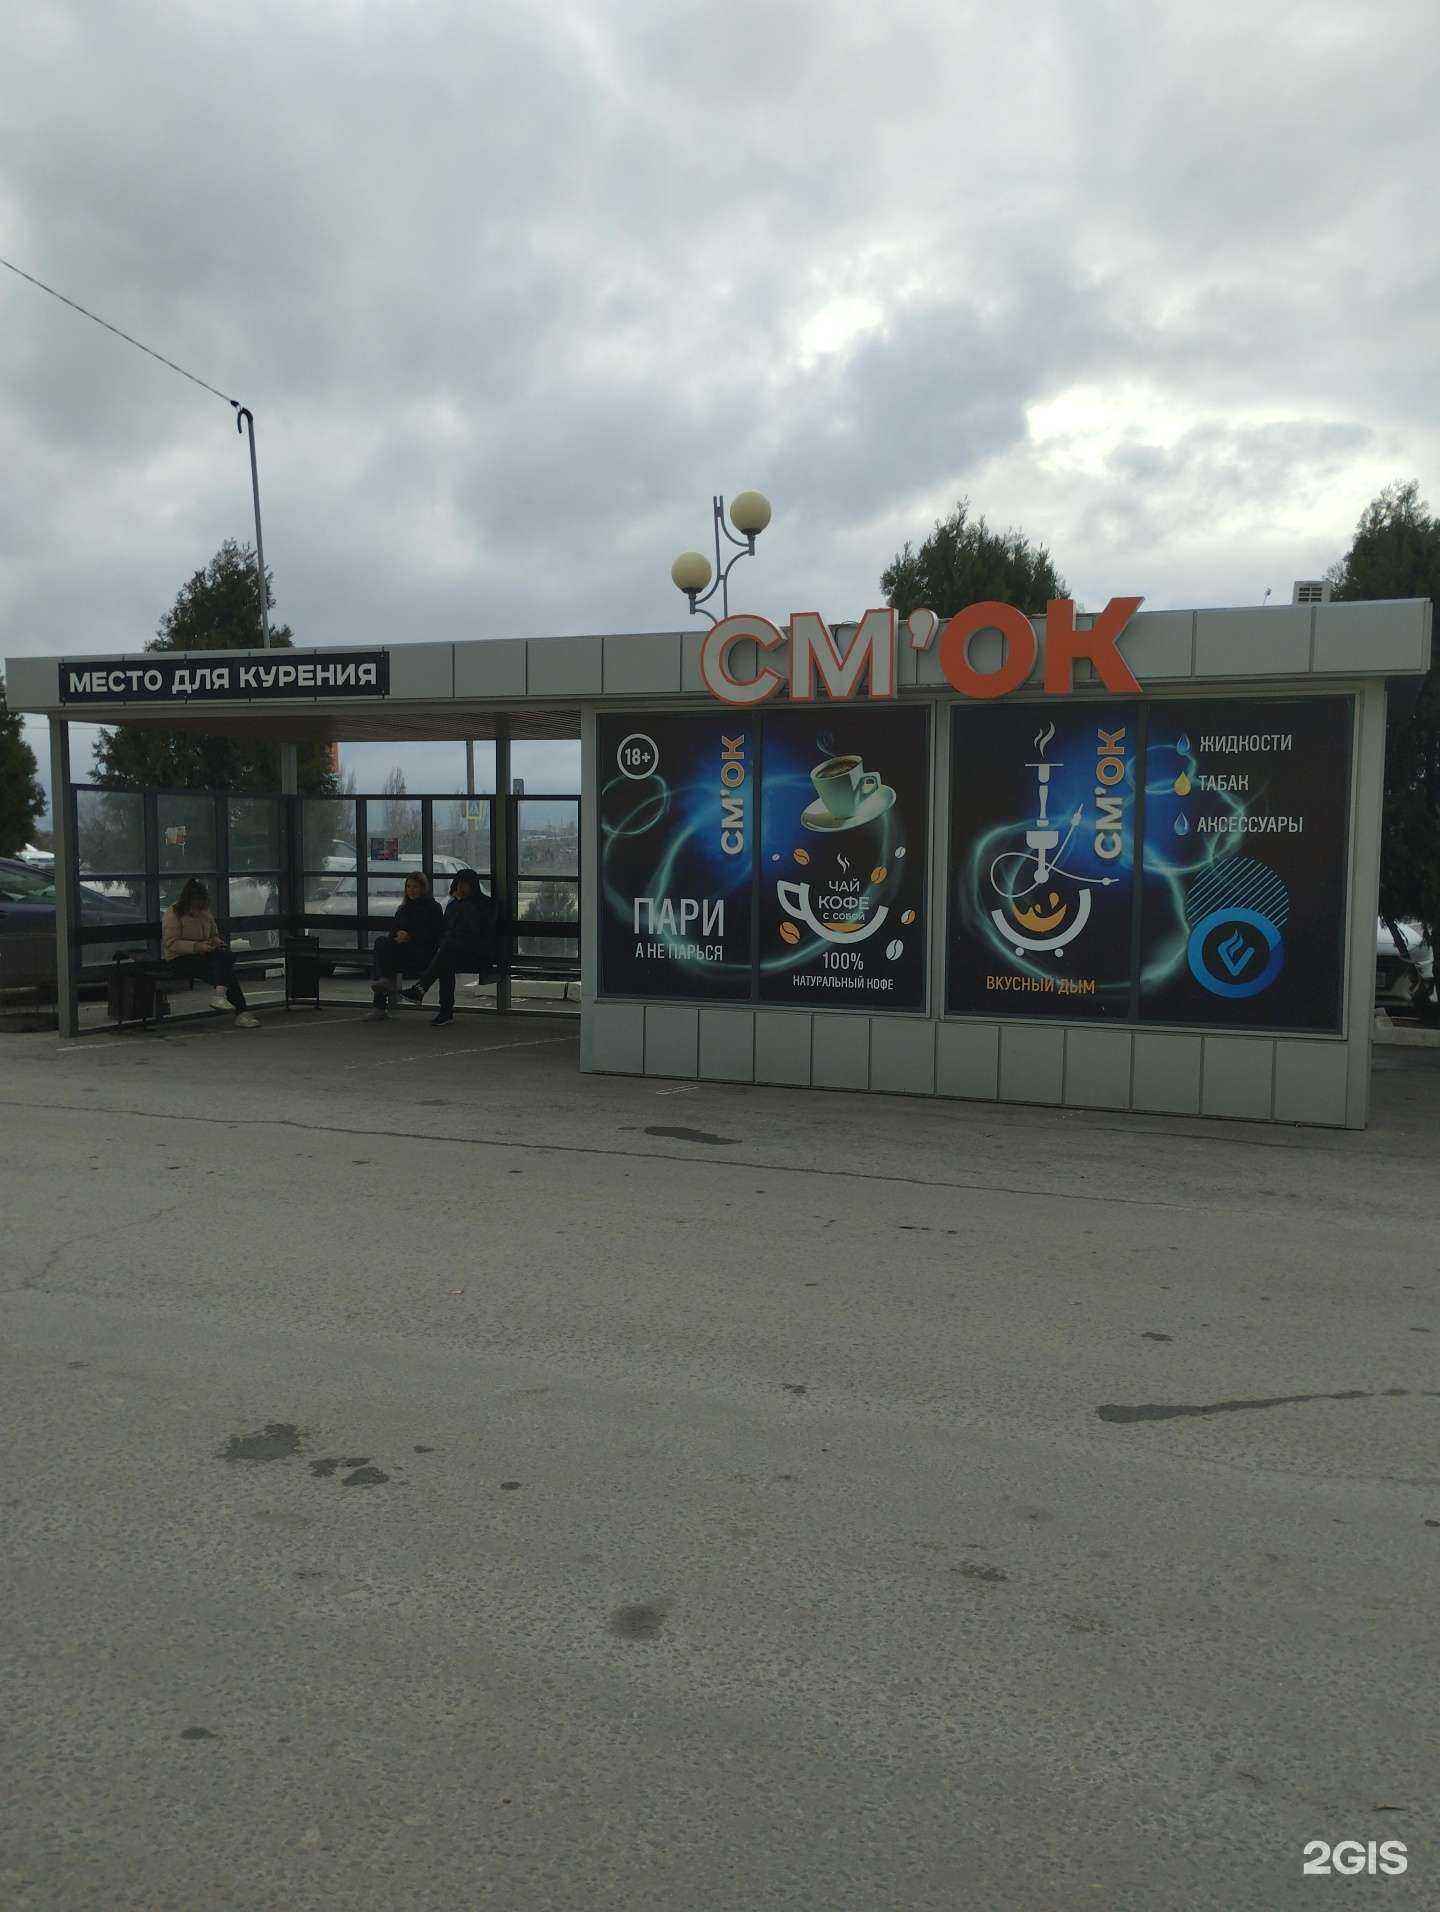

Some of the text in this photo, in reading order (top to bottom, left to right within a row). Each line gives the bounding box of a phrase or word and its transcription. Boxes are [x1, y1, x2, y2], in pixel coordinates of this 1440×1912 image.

[69, 663, 377, 694] МЕСТО ДЛЯ КУРЕНИЯ
[1199, 734, 1293, 754] ЖИДКОСТИ
[625, 747, 651, 766] 18+
[1198, 774, 1249, 792] ТАБАК
[1197, 816, 1304, 834] АКСЕССУАРЫ
[828, 878, 860, 893] ЧАЙ
[818, 895, 870, 910] КОФЕ
[632, 897, 725, 937] ПАРИ
[635, 944, 723, 961] А НЕ ПАРЬСЯ
[822, 951, 864, 970] 100%
[793, 974, 894, 991] НАТУРАЛЬНЫЙ КОФЕ
[986, 975, 1096, 995] ВКУСНЫЙ ДЫМ
